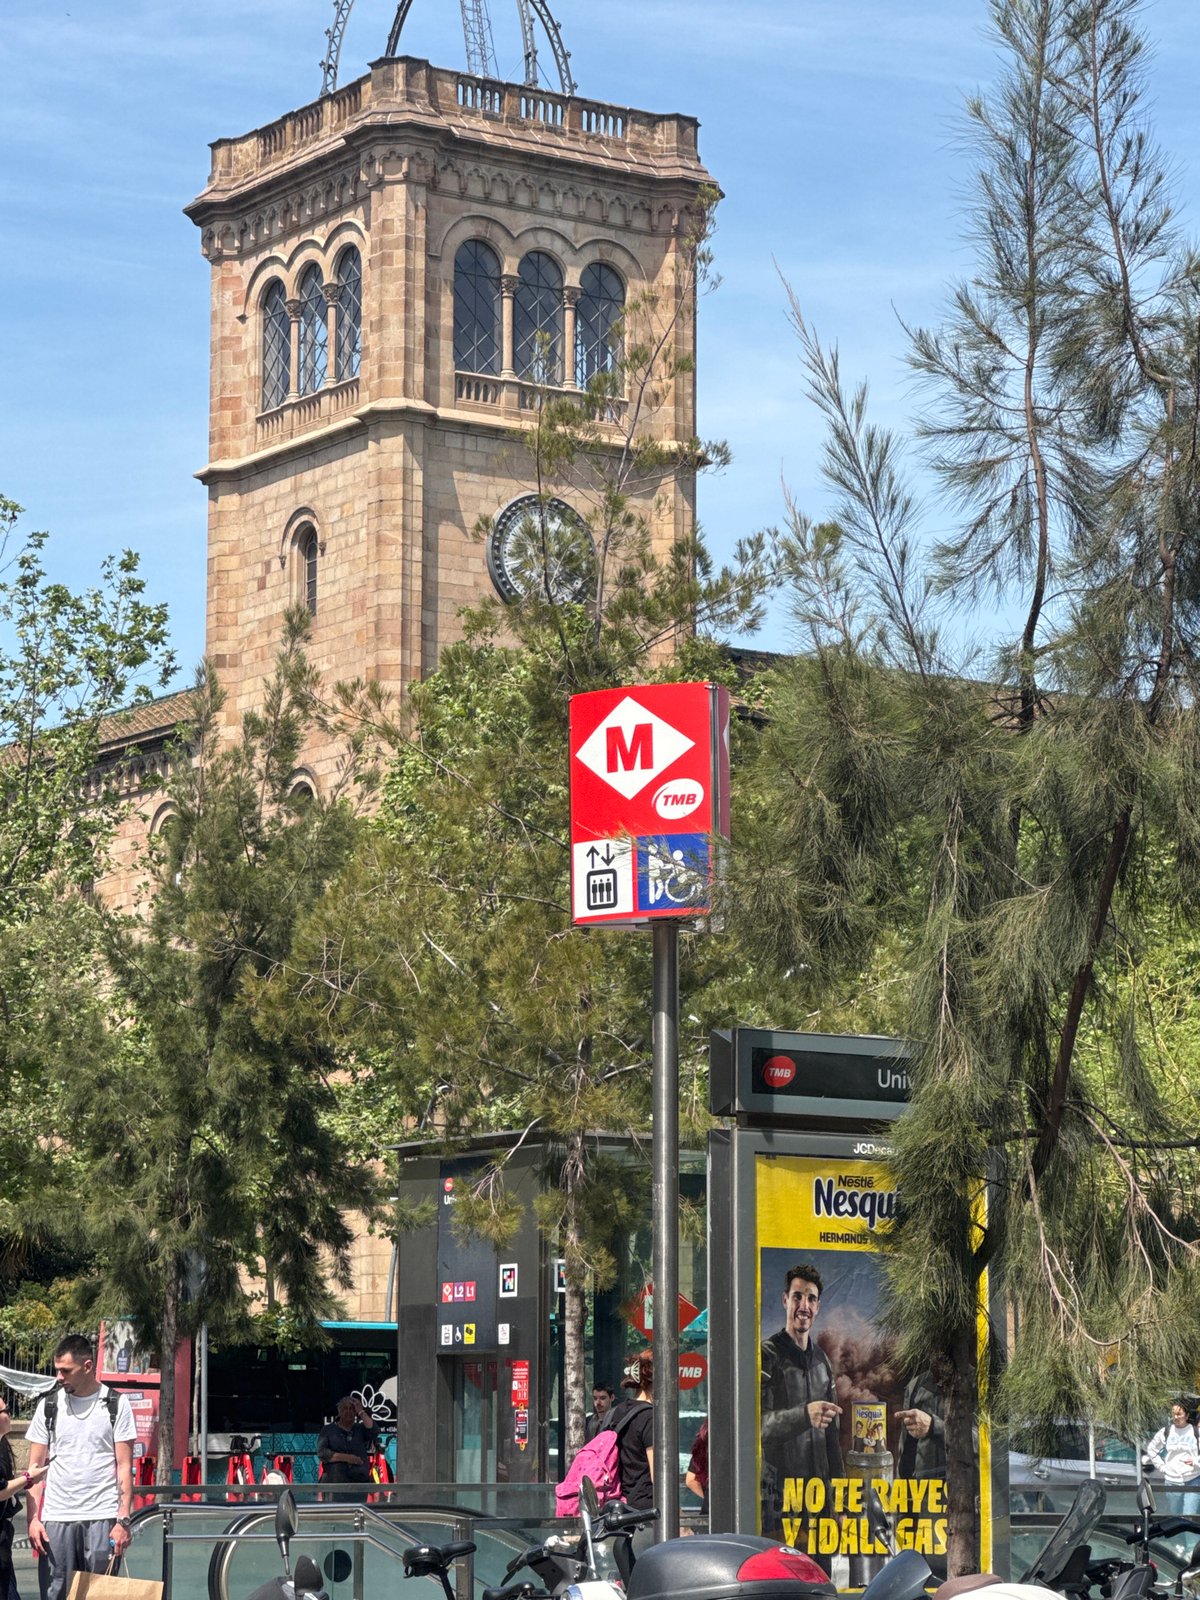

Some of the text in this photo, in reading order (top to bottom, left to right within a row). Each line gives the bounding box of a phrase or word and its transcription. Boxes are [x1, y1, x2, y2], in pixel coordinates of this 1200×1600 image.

[606, 723, 654, 774] M
[663, 793, 697, 806] TMB
[769, 1067, 792, 1078] TMB
[819, 1231, 869, 1245] HERMANOS
[454, 1285, 475, 1298] L2 L1
[783, 1477, 826, 1513] NO
[831, 1478, 863, 1512] TE
[782, 1518, 802, 1547] Y
